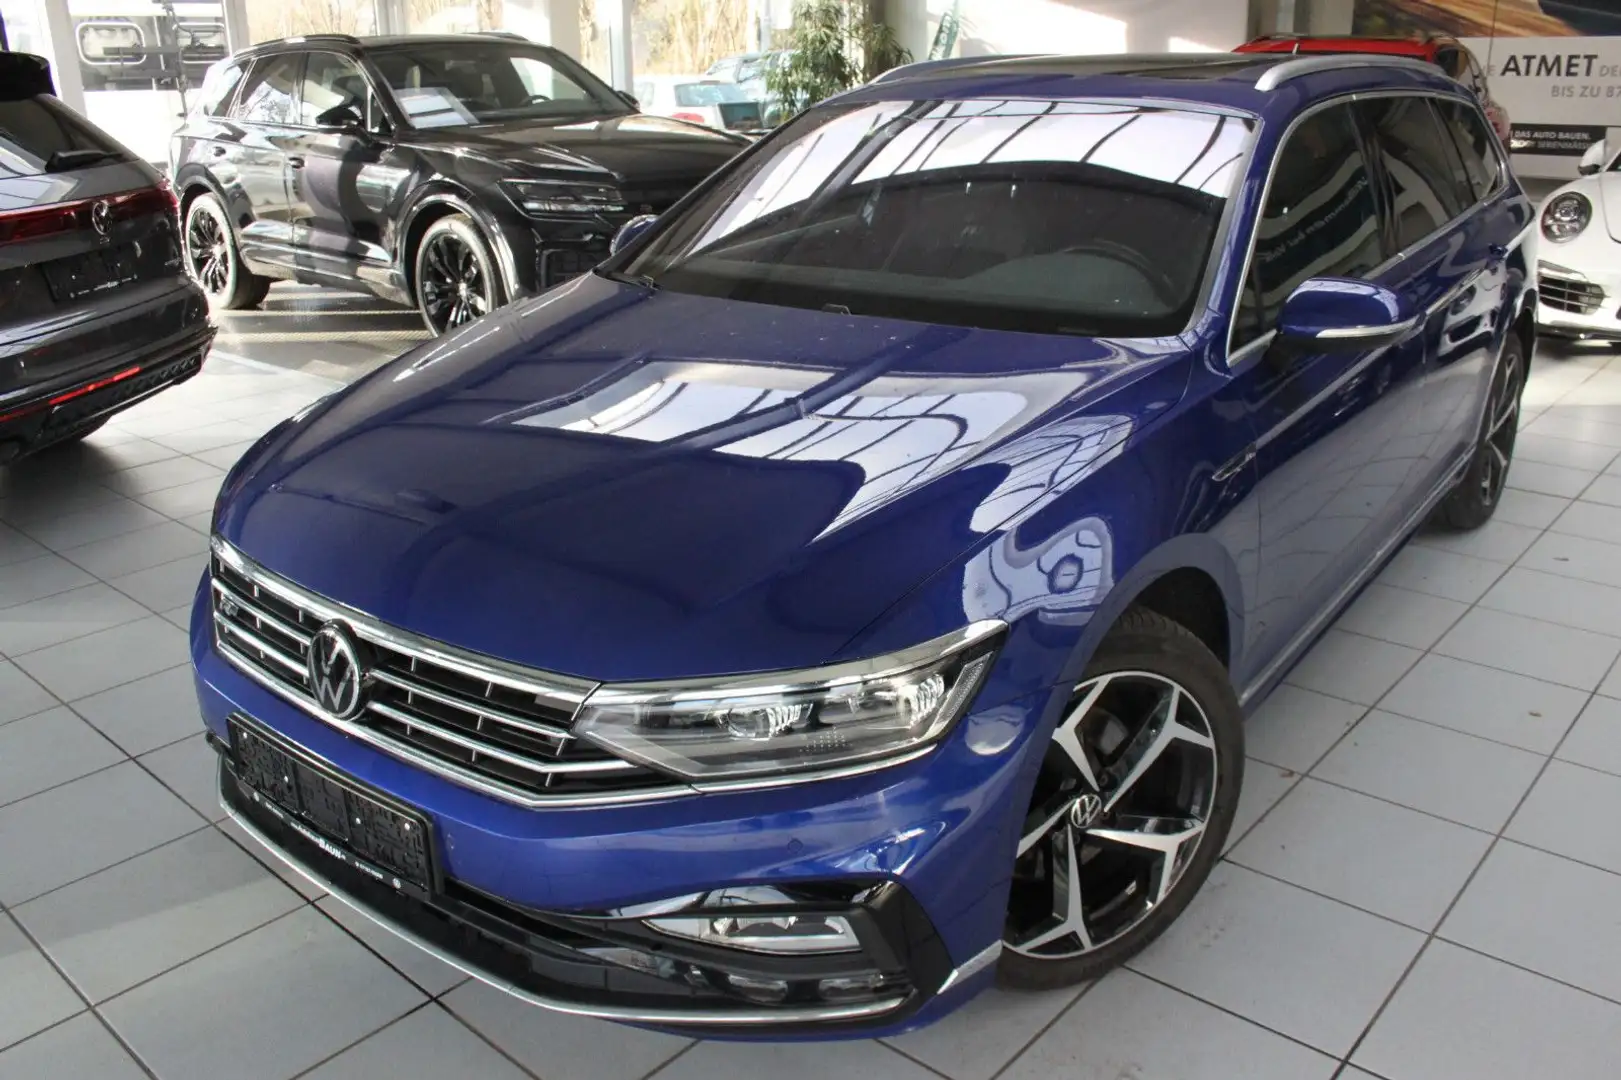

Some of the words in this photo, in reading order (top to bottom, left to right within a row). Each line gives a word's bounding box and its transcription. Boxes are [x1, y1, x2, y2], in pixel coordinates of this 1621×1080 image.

[1500, 54, 1598, 77] ATMET
[1599, 64, 1621, 77] DE
[1551, 85, 1574, 98] BIS
[1579, 85, 1601, 98] ZU
[1533, 131, 1557, 139] AUTO
